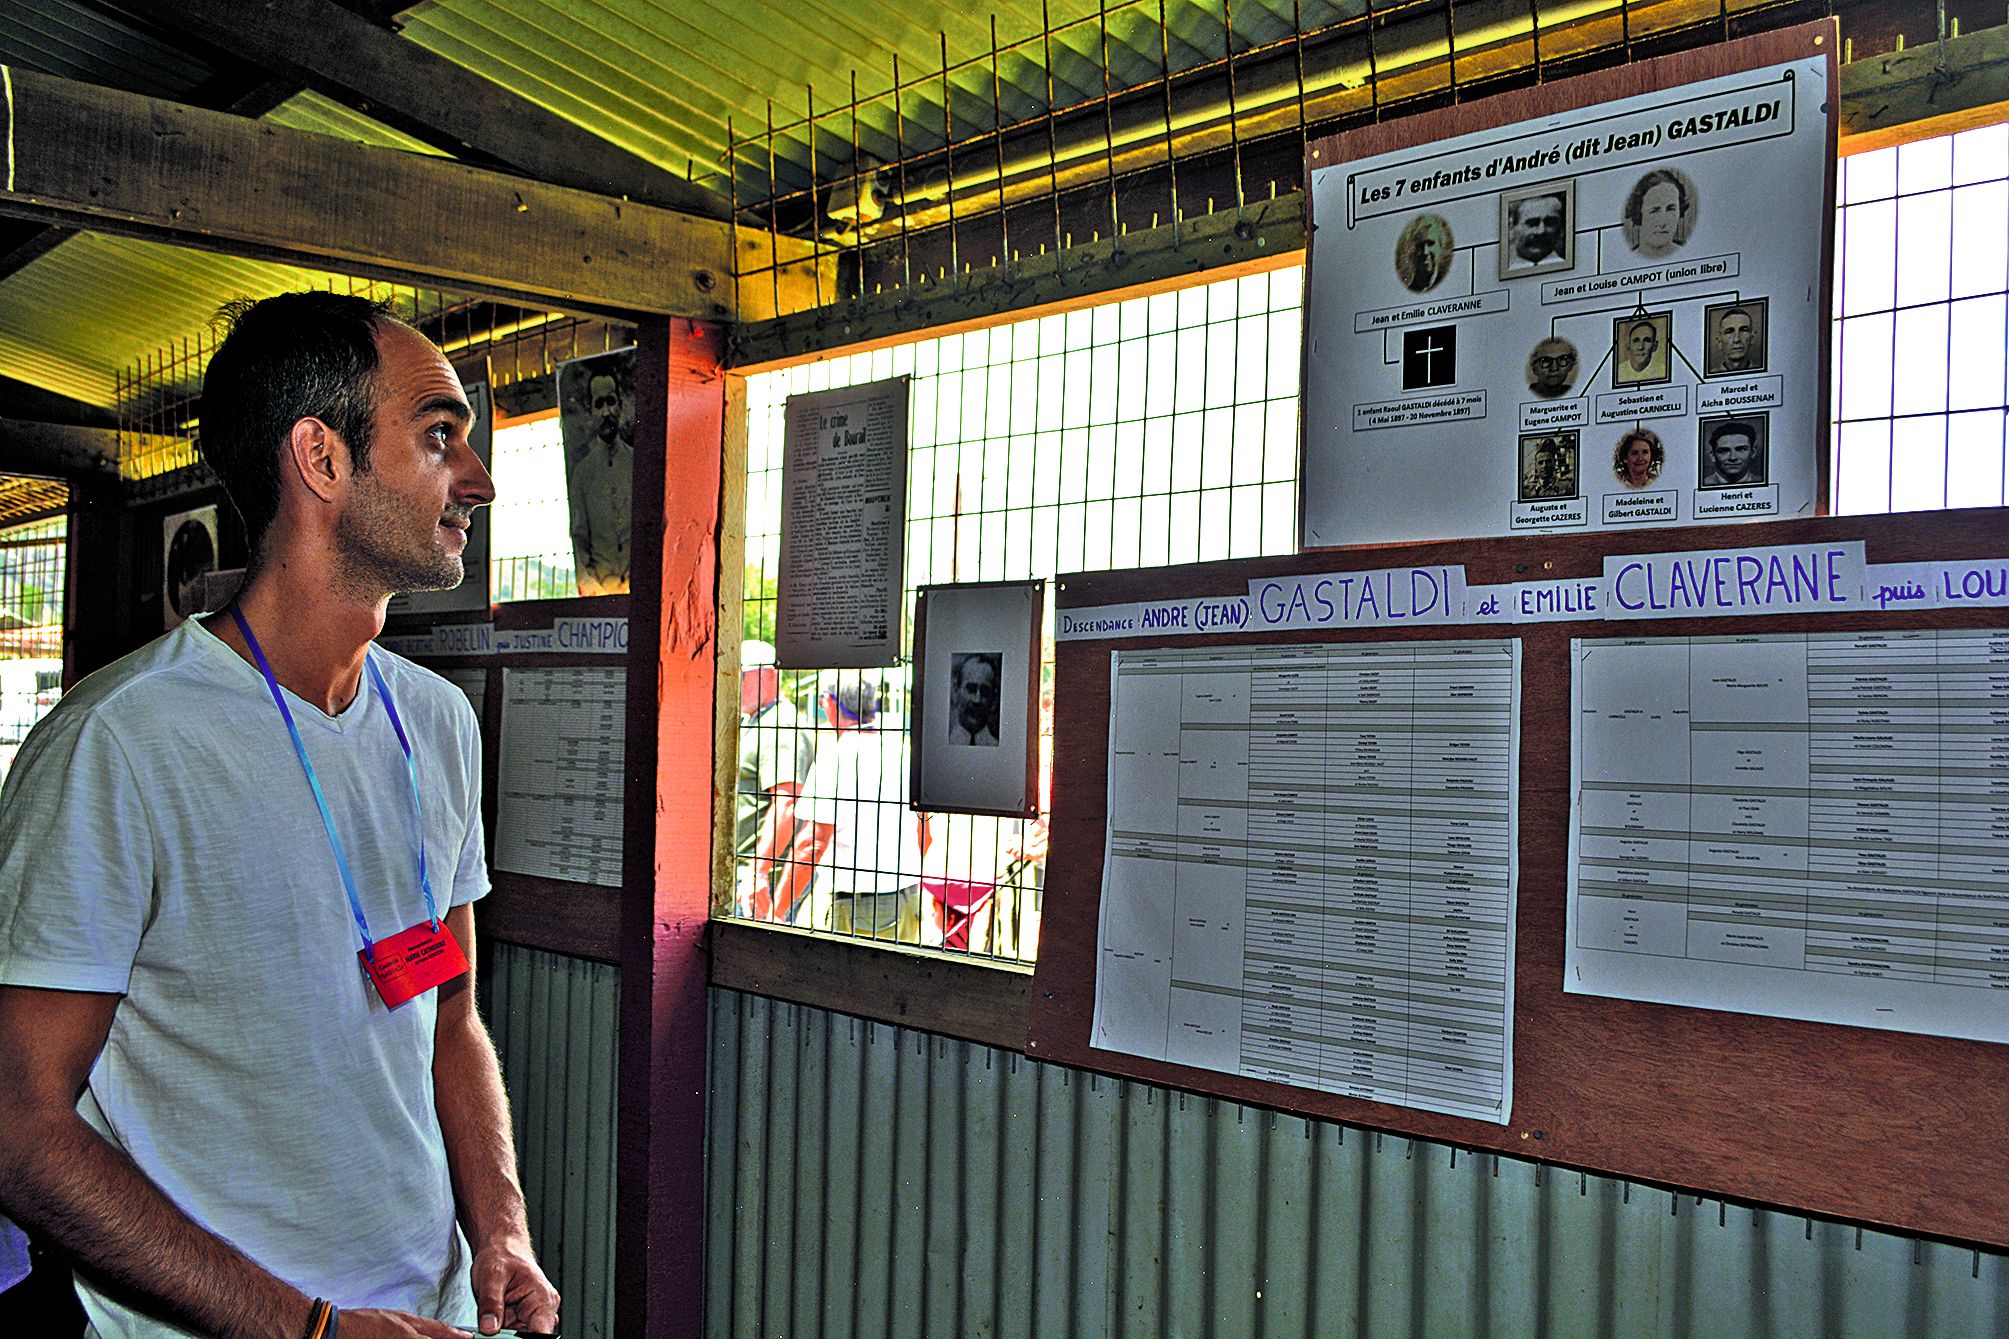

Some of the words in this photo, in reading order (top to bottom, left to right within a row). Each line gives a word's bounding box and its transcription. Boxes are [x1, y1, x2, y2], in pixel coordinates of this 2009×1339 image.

[1361, 187, 1391, 204] Les
[1395, 179, 1407, 196] 7
[1410, 165, 1482, 194] enfants
[1485, 144, 1561, 178] d'André
[1565, 138, 1600, 165] (dit
[1603, 125, 1662, 154] Jean)
[1667, 100, 1780, 140] GASTALDI
[1554, 287, 1574, 297] Jean
[1577, 284, 1586, 293] et
[1588, 280, 1617, 291] Louise
[1620, 271, 1662, 286] CAMPOT
[1665, 267, 1697, 281] (union
[1700, 261, 1727, 275] libre)
[1372, 316, 1389, 325] Jean
[1392, 313, 1400, 321] et
[1401, 309, 1425, 320] Emilie
[1427, 299, 1482, 316] CLAVERANNE
[1721, 384, 1748, 394] Marcel
[1725, 394, 1774, 405] BOUSSENAH
[1363, 407, 1382, 415] enfant
[1383, 404, 1401, 413] Raoul
[1401, 401, 1432, 410] GASTALDI
[1530, 405, 1568, 415] Marguerite
[1601, 408, 1638, 418] Augustine
[1639, 404, 1681, 414] CARNICELLI
[1377, 415, 1389, 423] Mai
[1419, 410, 1452, 420] Novembre
[1550, 413, 1582, 423] CAMPOT
[1721, 492, 1743, 500] Henri
[1615, 498, 1654, 507] Madeleine
[1699, 505, 1735, 513] Lucienne
[1736, 502, 1771, 511] CAZERES
[1530, 504, 1558, 513] Auguste
[1608, 509, 1634, 518] Gilbert
[1635, 507, 1672, 517] GASTALDI
[1515, 515, 1550, 524] Georgette
[1551, 513, 1581, 522] CAZERES
[1063, 615, 1133, 634] DESCENDANCE
[1141, 605, 1189, 628] ANDRE
[1194, 598, 1250, 632] (JEAN)
[1260, 568, 1450, 624] GASTALDI
[1476, 594, 1501, 616] et
[1615, 551, 1847, 610] CLAVERANE
[1872, 580, 1926, 610] puis
[1944, 568, 2007, 599] LOU
